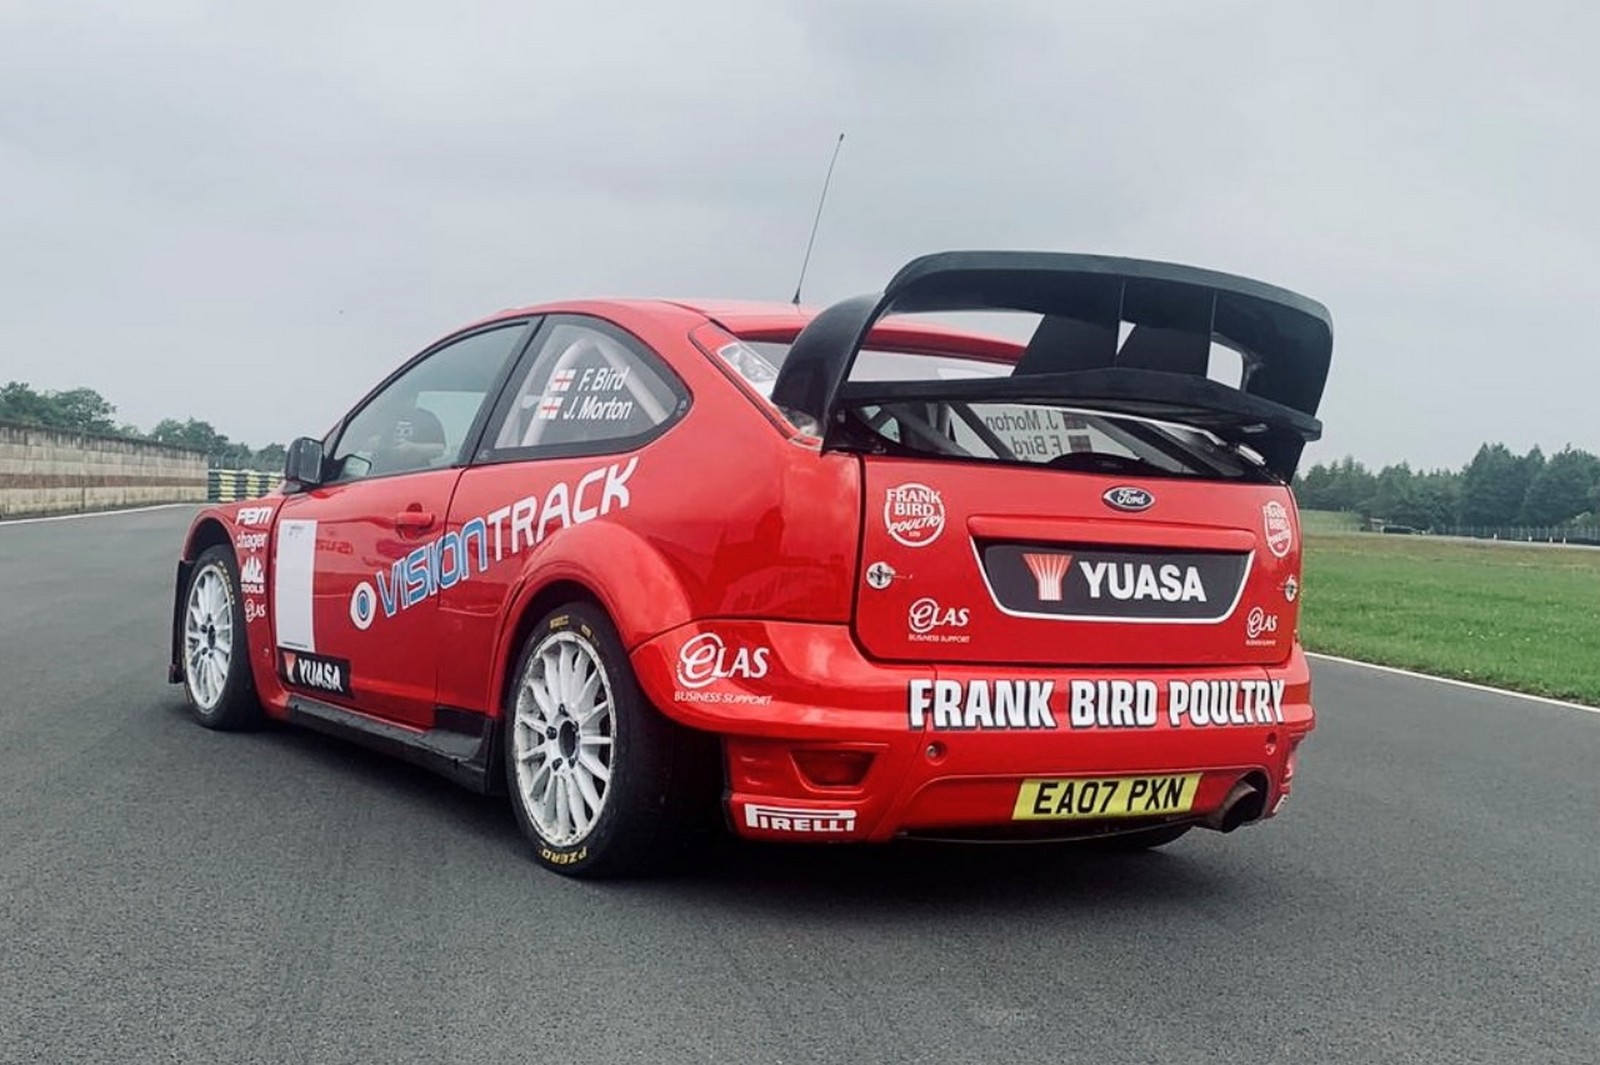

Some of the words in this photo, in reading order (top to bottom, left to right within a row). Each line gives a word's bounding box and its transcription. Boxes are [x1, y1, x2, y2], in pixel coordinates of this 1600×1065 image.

[577, 368, 595, 391] F.
[591, 366, 630, 392] Bird
[563, 396, 580, 420] J.
[577, 395, 633, 420] Morton
[886, 488, 942, 503] FRANK
[1117, 489, 1146, 505] Ford
[894, 502, 935, 517] BIRD
[1079, 561, 1207, 602] YUASA
[298, 658, 344, 692] YUASA
[674, 690, 721, 703] BUSINESS
[721, 692, 773, 706] SUPPORT
[910, 679, 1057, 730] FRANK
[1070, 680, 1158, 729] BIRD
[1168, 679, 1285, 727] POULTRY
[1033, 780, 1121, 815] EA07
[1127, 777, 1187, 809] PXN
[744, 803, 857, 832] PIRELLI
